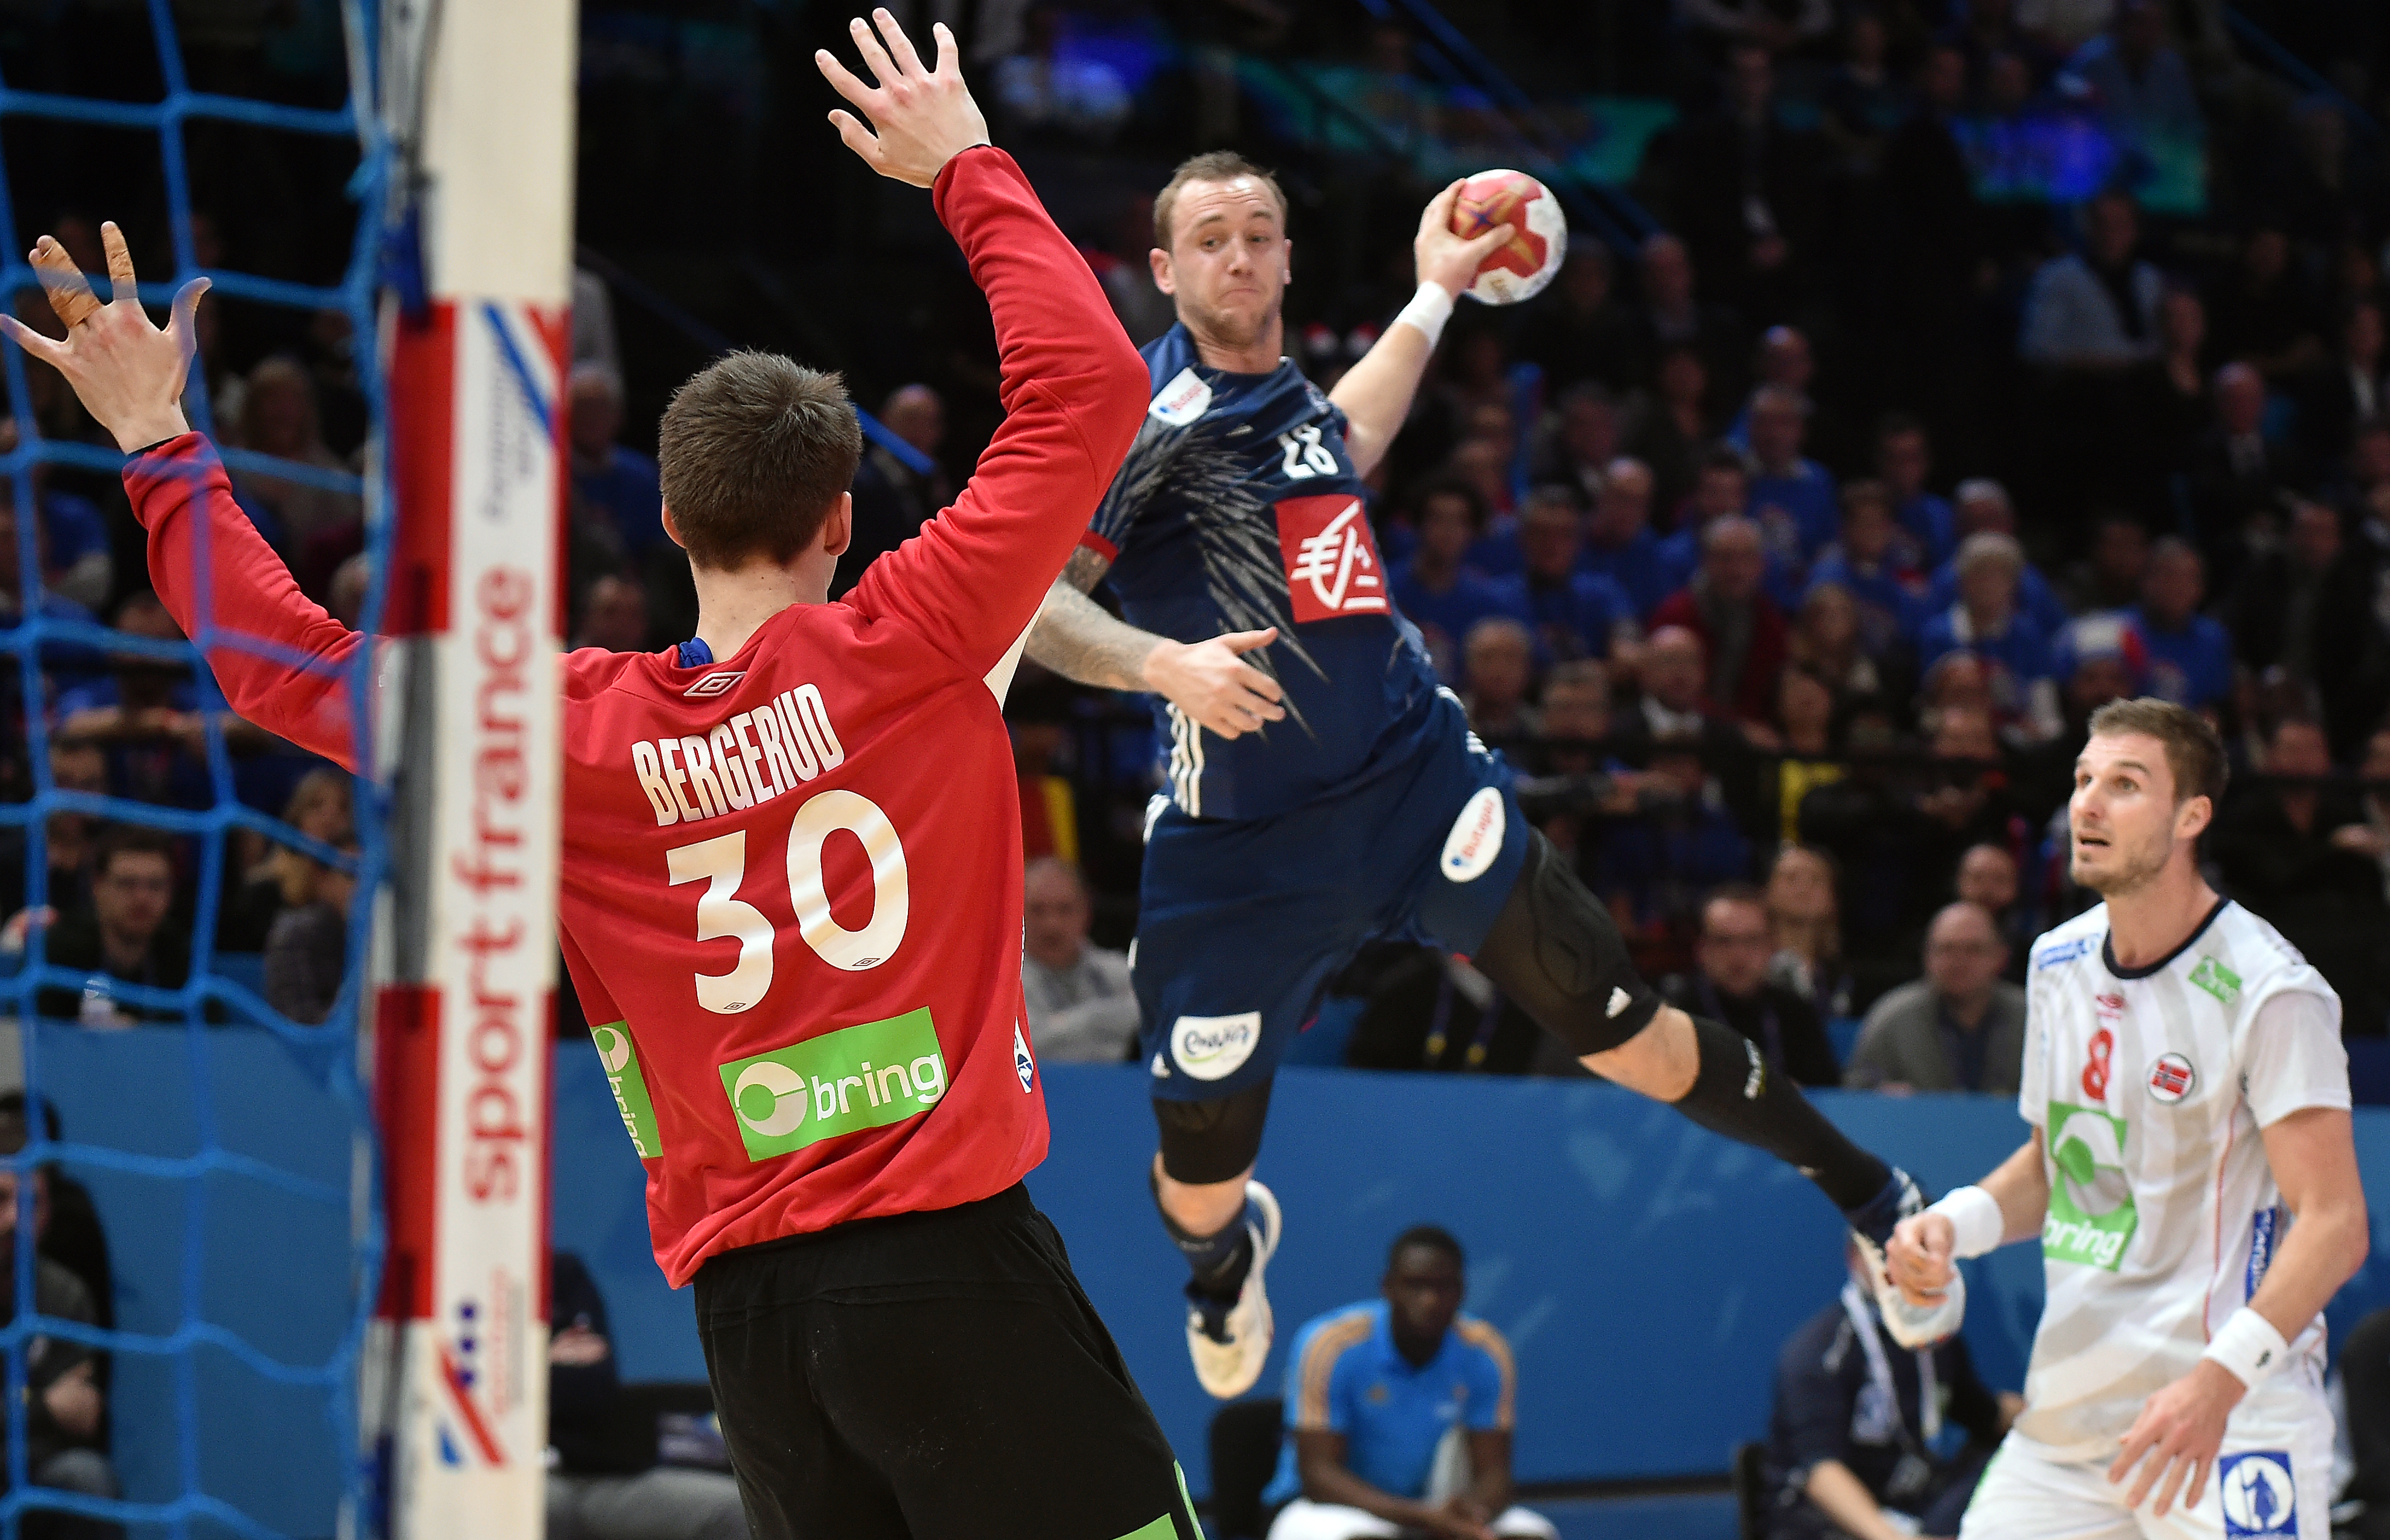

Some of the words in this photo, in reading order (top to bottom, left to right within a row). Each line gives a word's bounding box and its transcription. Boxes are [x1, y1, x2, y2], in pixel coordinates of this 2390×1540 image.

[1277, 422, 1339, 480] 28
[452, 565, 534, 900] france
[632, 683, 844, 826] BERGERUD
[666, 789, 909, 1014] 30
[457, 915, 530, 1206] sport
[815, 1053, 944, 1121] bring
[2082, 1029, 2113, 1100] 8
